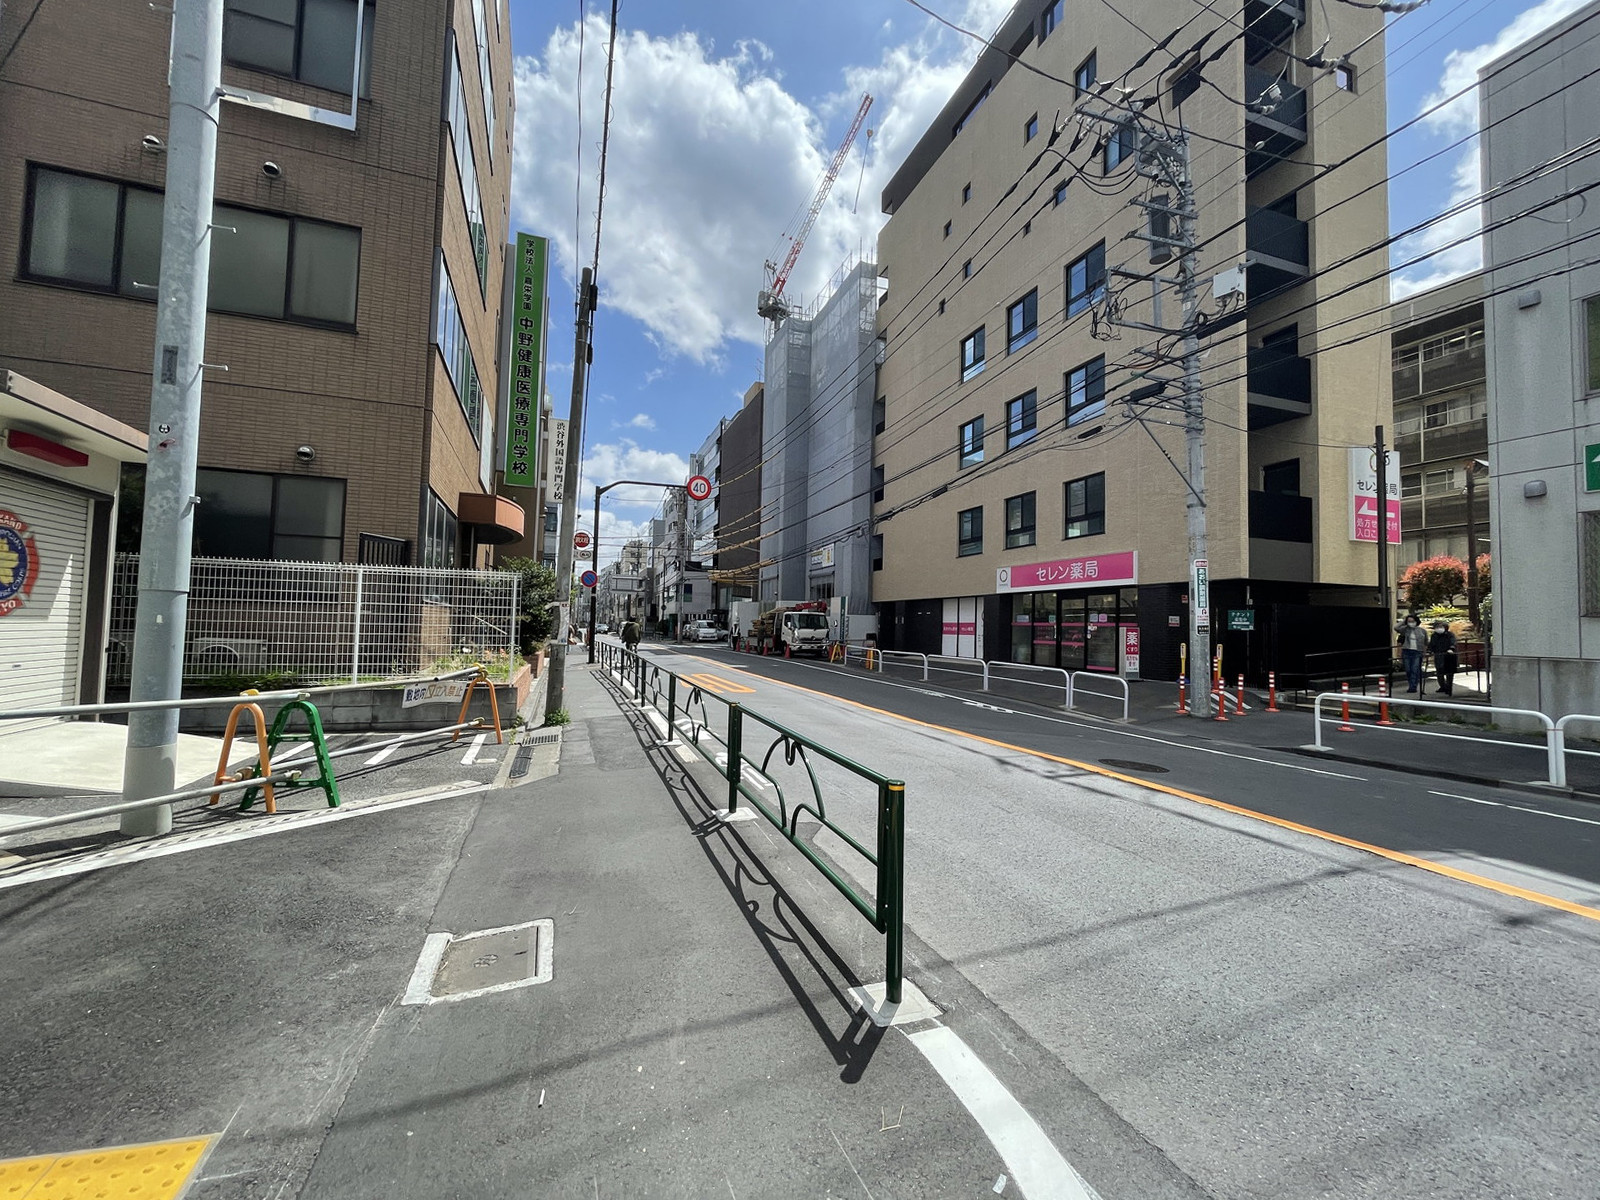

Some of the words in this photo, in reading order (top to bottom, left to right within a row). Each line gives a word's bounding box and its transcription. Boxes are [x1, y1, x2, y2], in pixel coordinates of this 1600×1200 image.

[512, 317, 533, 476] 中野健康医療専門学校
[553, 422, 566, 500] 渋谷外国語専門学校
[693, 482, 706, 494] 40
[1356, 518, 1398, 531] 処方せ受付
[1036, 560, 1099, 582] セレン薬局
[1126, 632, 1138, 646] 薬
